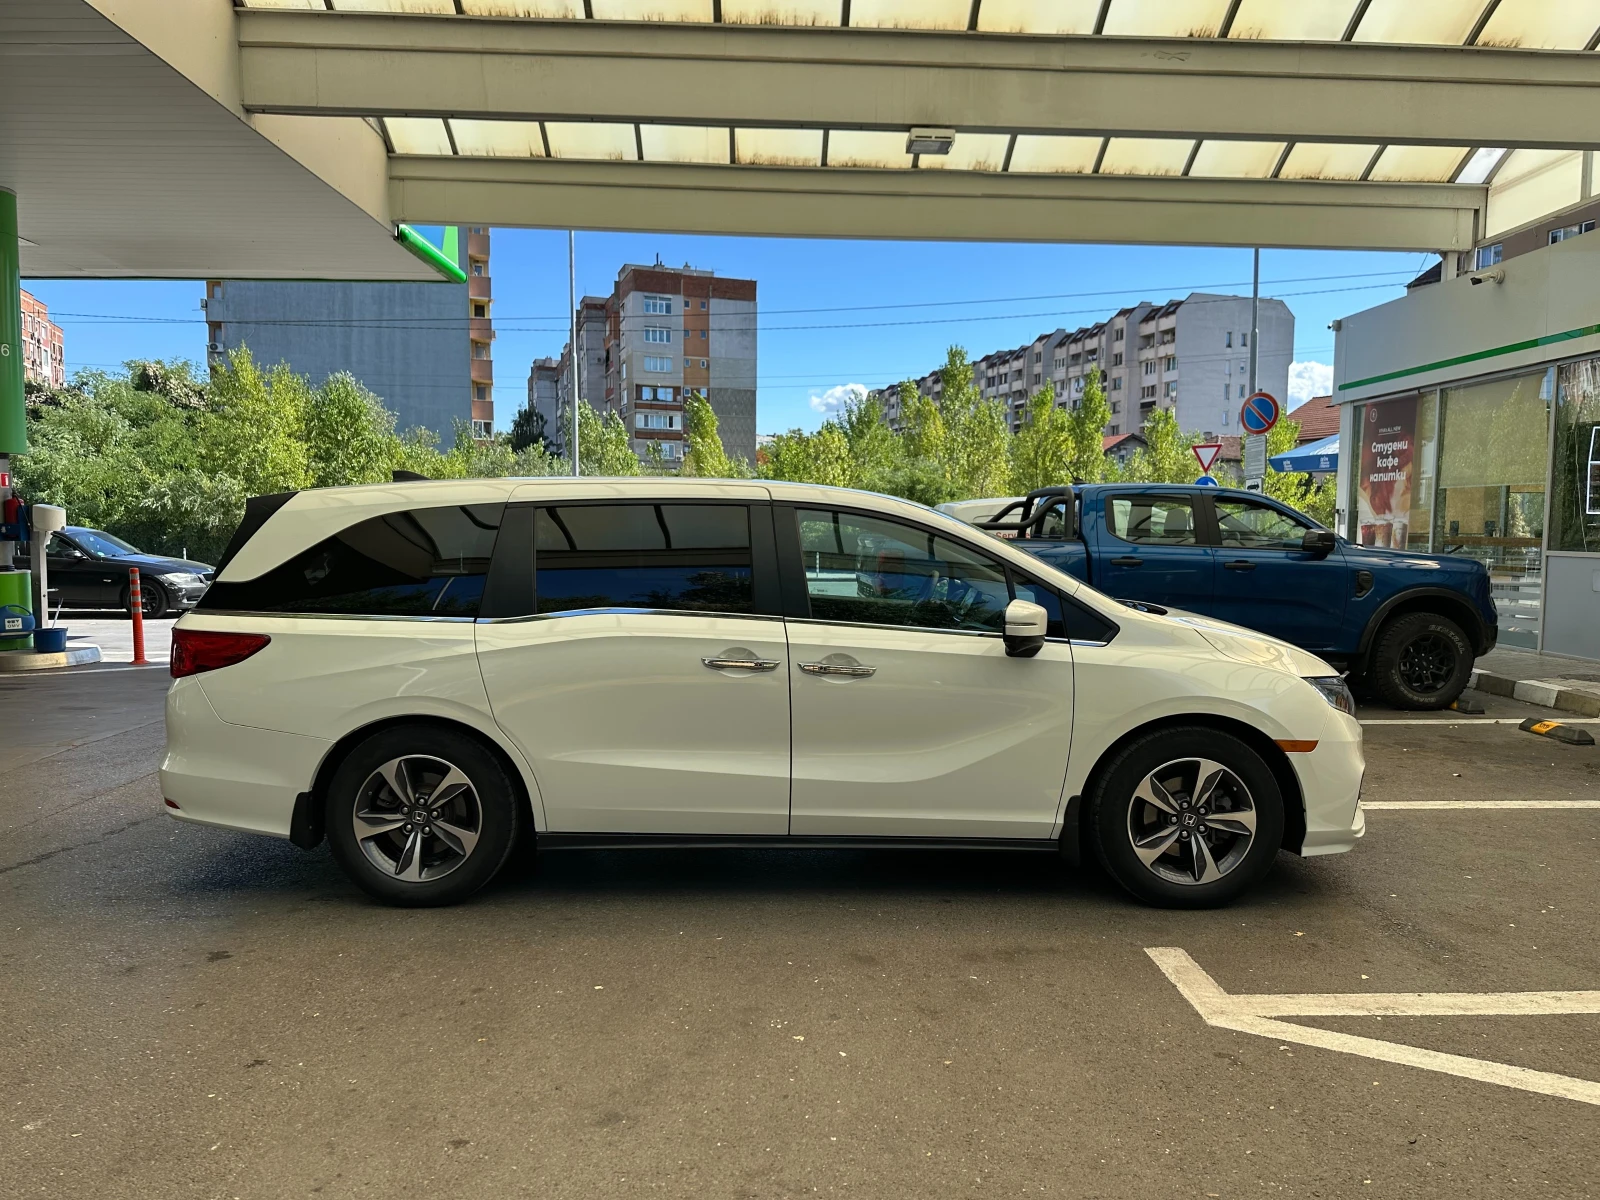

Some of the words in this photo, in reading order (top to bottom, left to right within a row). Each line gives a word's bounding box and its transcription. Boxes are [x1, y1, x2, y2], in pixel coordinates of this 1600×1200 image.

[1, 344, 9, 356] 6
[1371, 440, 1408, 454] Студени
[1376, 455, 1399, 469] кафе
[1369, 469, 1406, 482] напитки
[995, 531, 1031, 540] Serve
